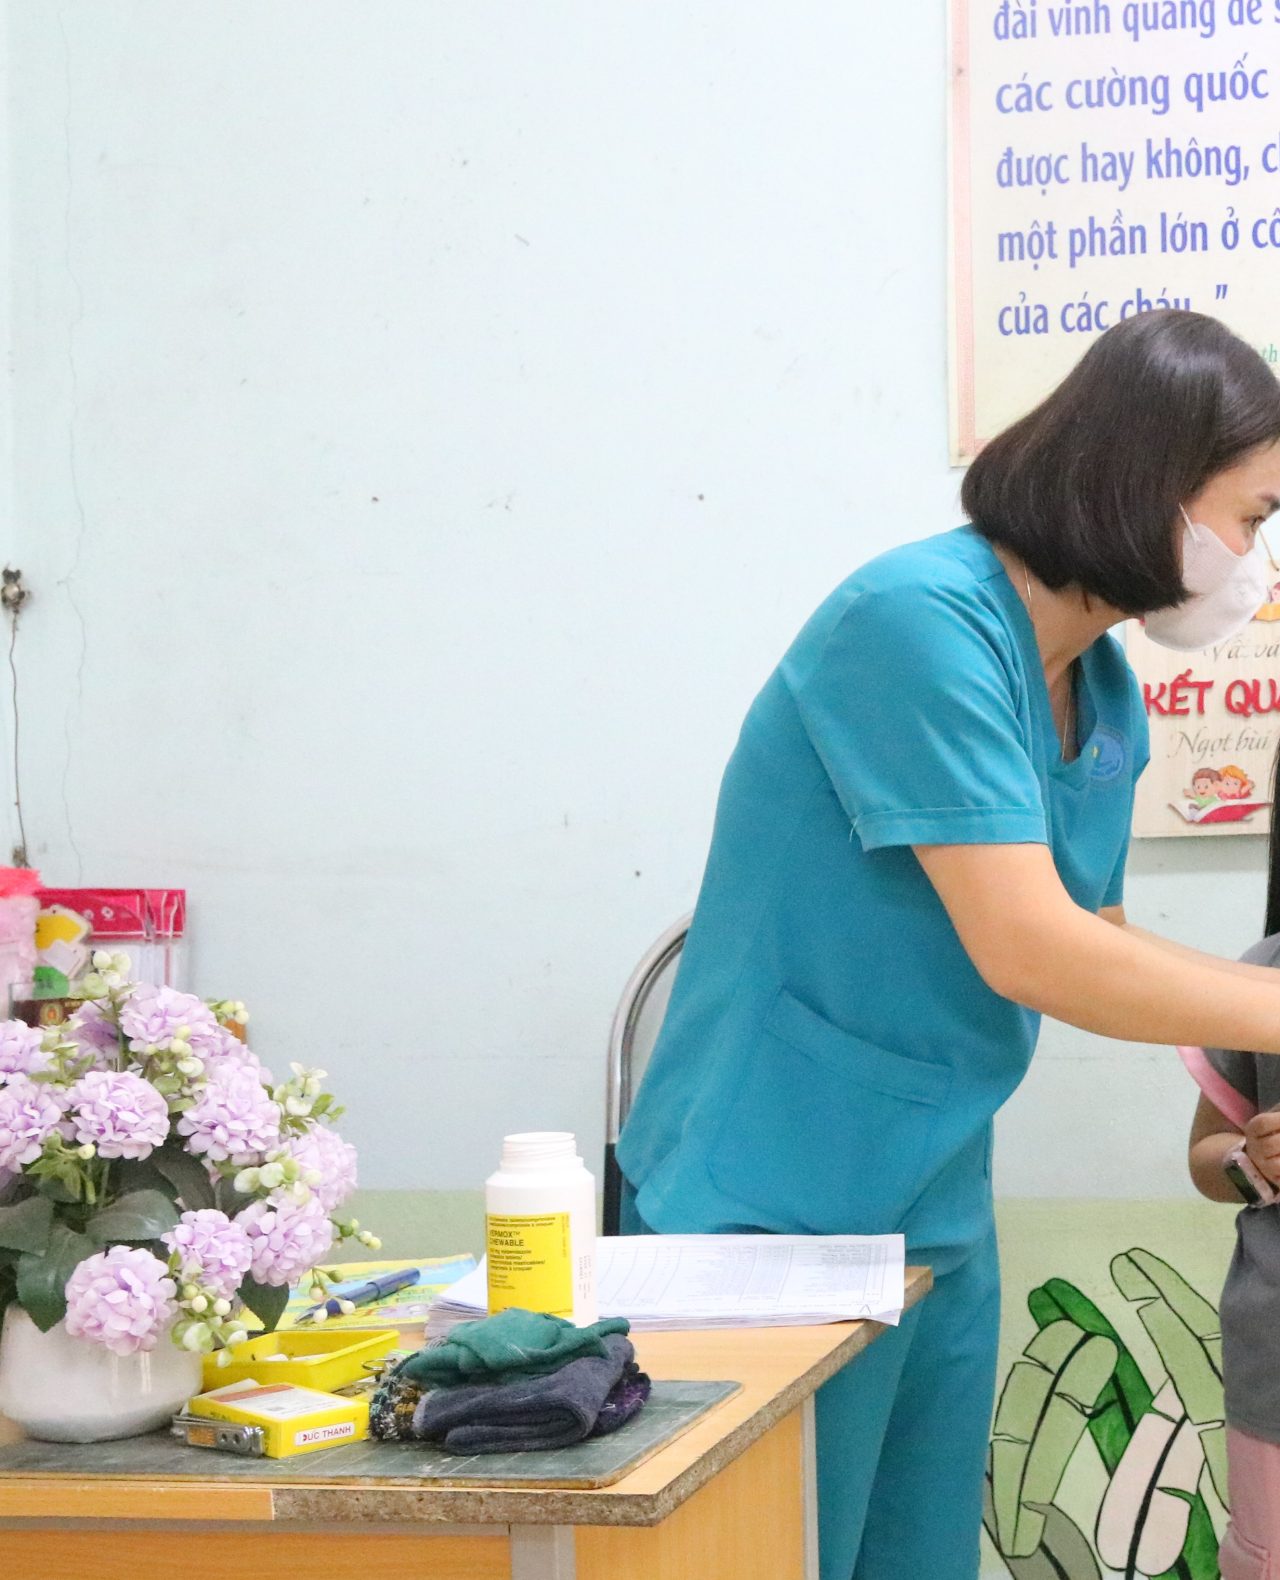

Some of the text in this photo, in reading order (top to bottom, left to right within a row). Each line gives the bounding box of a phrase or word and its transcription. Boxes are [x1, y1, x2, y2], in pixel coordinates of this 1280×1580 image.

[1048, 0, 1110, 36] vinh
[995, 72, 1053, 113] các
[1065, 67, 1170, 115] cường
[1184, 52, 1269, 112] quốc
[997, 146, 1069, 196] được
[1081, 142, 1134, 191] hay
[1146, 137, 1249, 186] không,
[998, 220, 1058, 271] một
[1069, 209, 1147, 268] phần
[1160, 211, 1208, 253] lớn
[1221, 206, 1239, 250] ở
[998, 291, 1048, 336] của
[1060, 291, 1109, 332] các
[1144, 668, 1214, 717] KẾT
[1166, 726, 1232, 763] Ngọt
[322, 1425, 352, 1439] THANH
